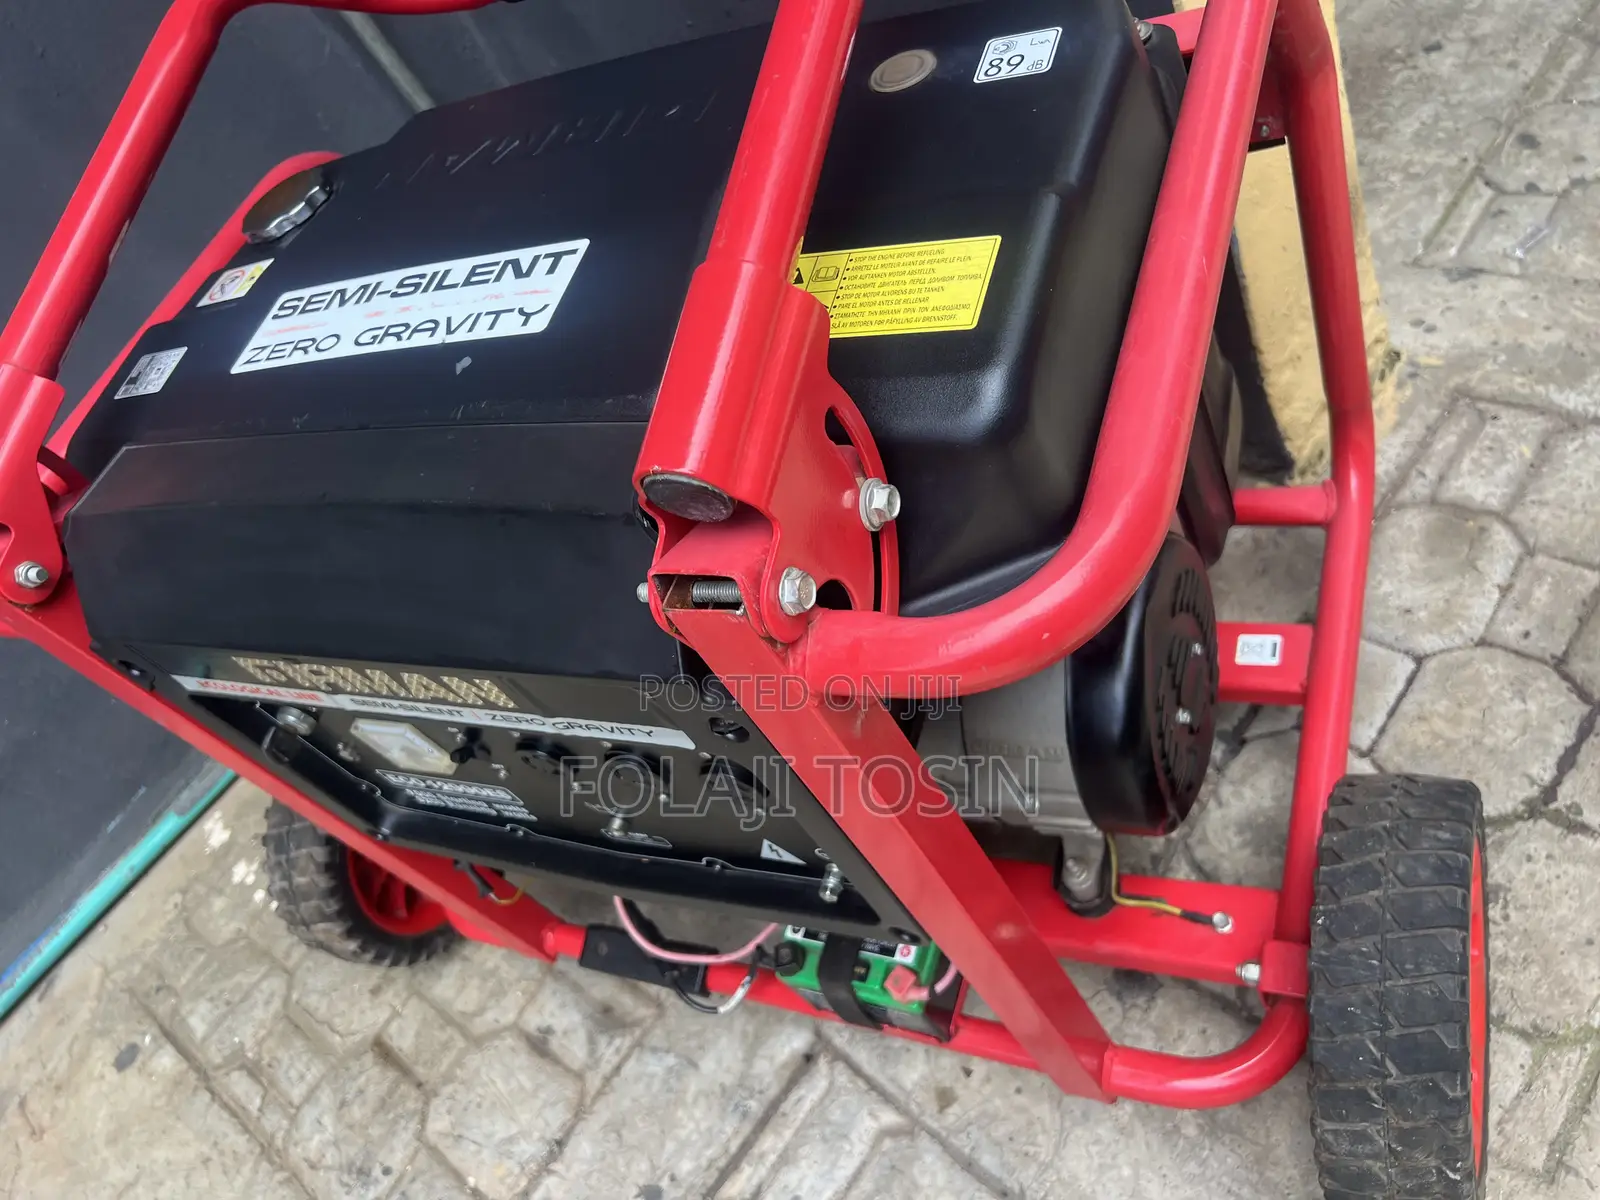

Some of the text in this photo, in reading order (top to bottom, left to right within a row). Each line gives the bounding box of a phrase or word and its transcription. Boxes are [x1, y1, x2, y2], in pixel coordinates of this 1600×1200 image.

[984, 54, 1043, 77] 89 dB
[272, 248, 578, 320] SEMI-SILENT
[240, 303, 551, 366] ZERO GRAVITY
[350, 698, 655, 738] SEMI-SILENT ZERO GRAVITY
